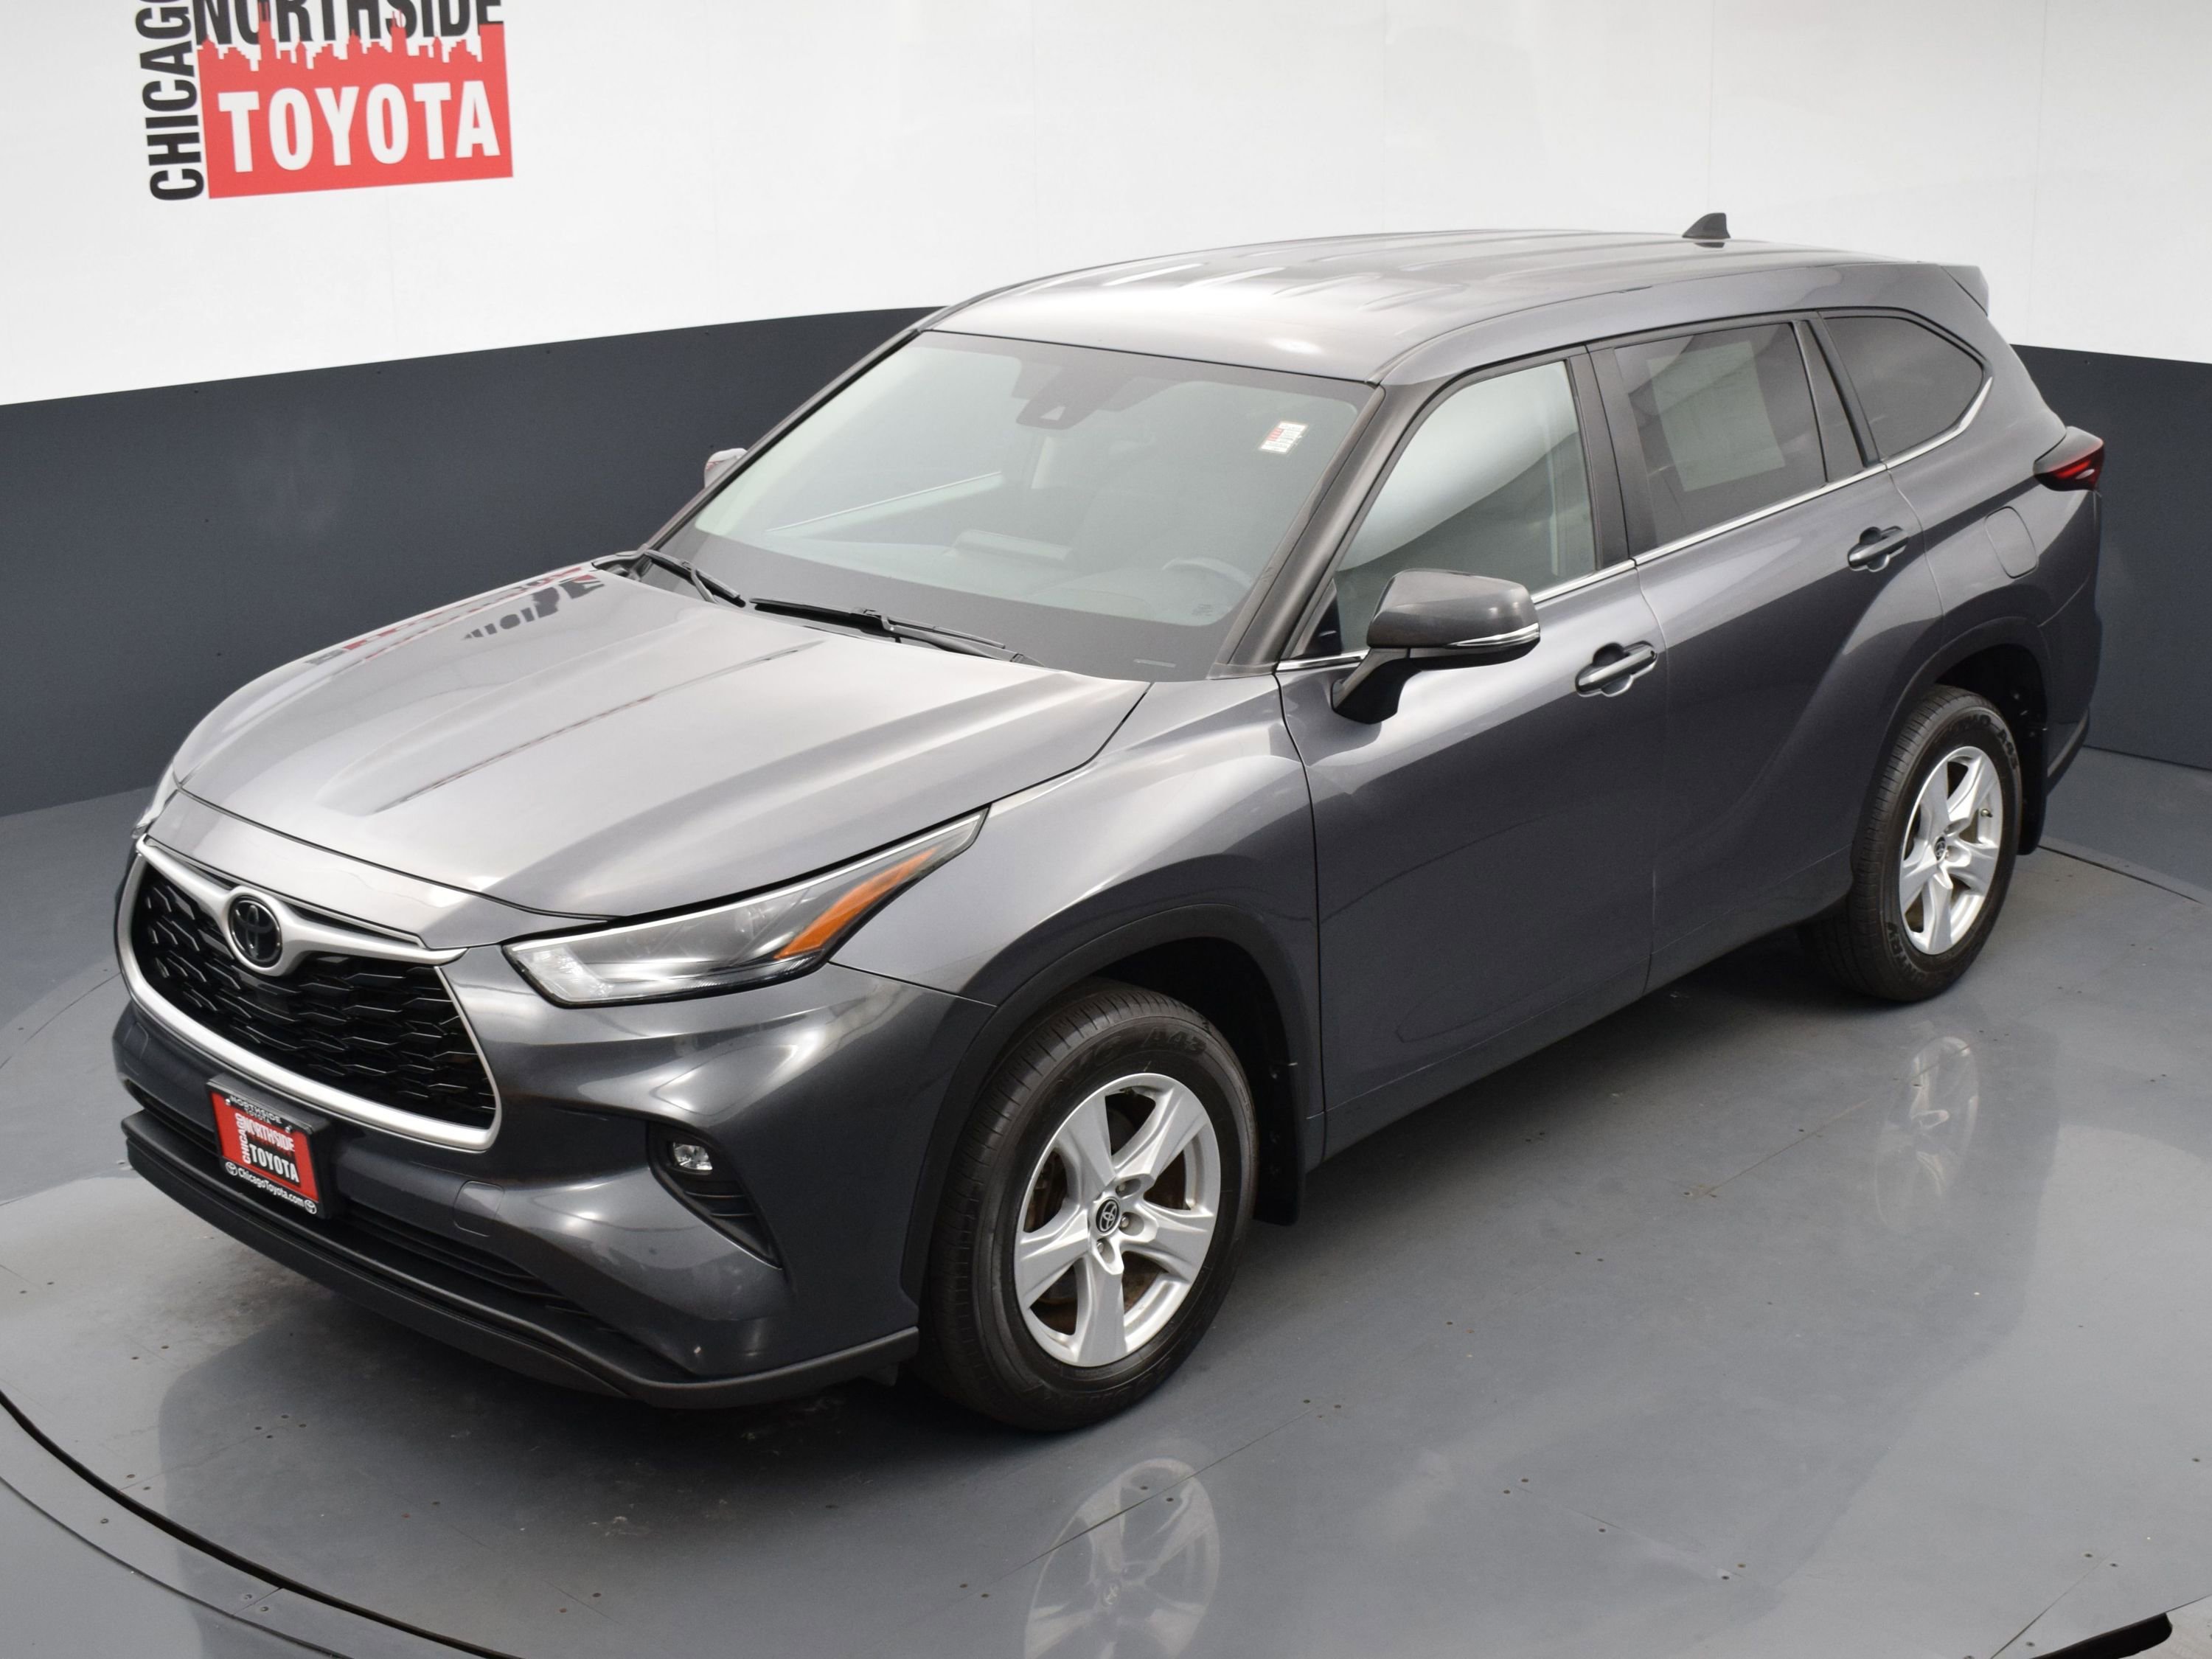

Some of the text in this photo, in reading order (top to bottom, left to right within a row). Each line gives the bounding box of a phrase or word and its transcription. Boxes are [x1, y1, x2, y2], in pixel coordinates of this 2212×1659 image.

[135, 0, 205, 201] CHICAG
[218, 80, 501, 173] TOYOTA
[235, 1113, 251, 1164] CHICAGO
[244, 1117, 295, 1152] NORTHSIDE
[249, 1143, 299, 1183] TOYOTA
[238, 1168, 305, 1207] ChicagoToyota.com
